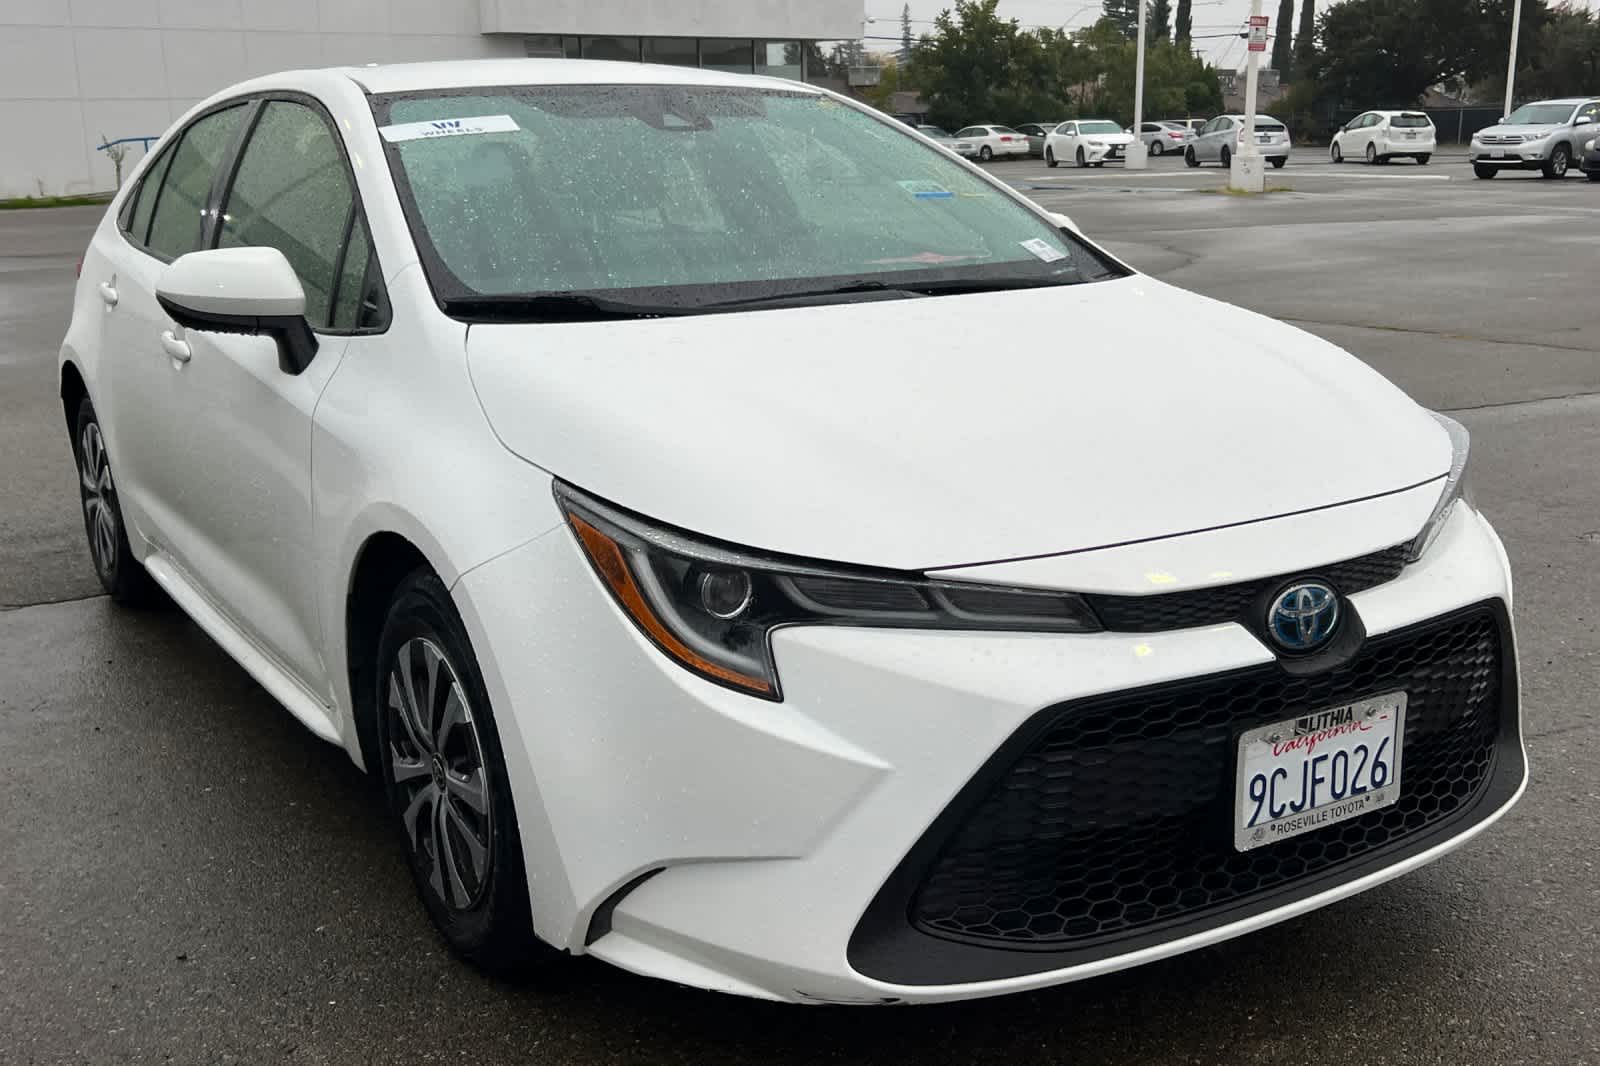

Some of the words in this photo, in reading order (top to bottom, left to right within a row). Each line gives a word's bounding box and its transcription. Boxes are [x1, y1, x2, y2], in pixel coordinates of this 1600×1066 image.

[422, 127, 483, 137] WHEELS
[1308, 707, 1353, 732] LITHIA
[1248, 736, 1390, 828] 9CJF026
[1277, 810, 1328, 835] ROSEVILLE
[1330, 799, 1365, 818] TOYOTA
